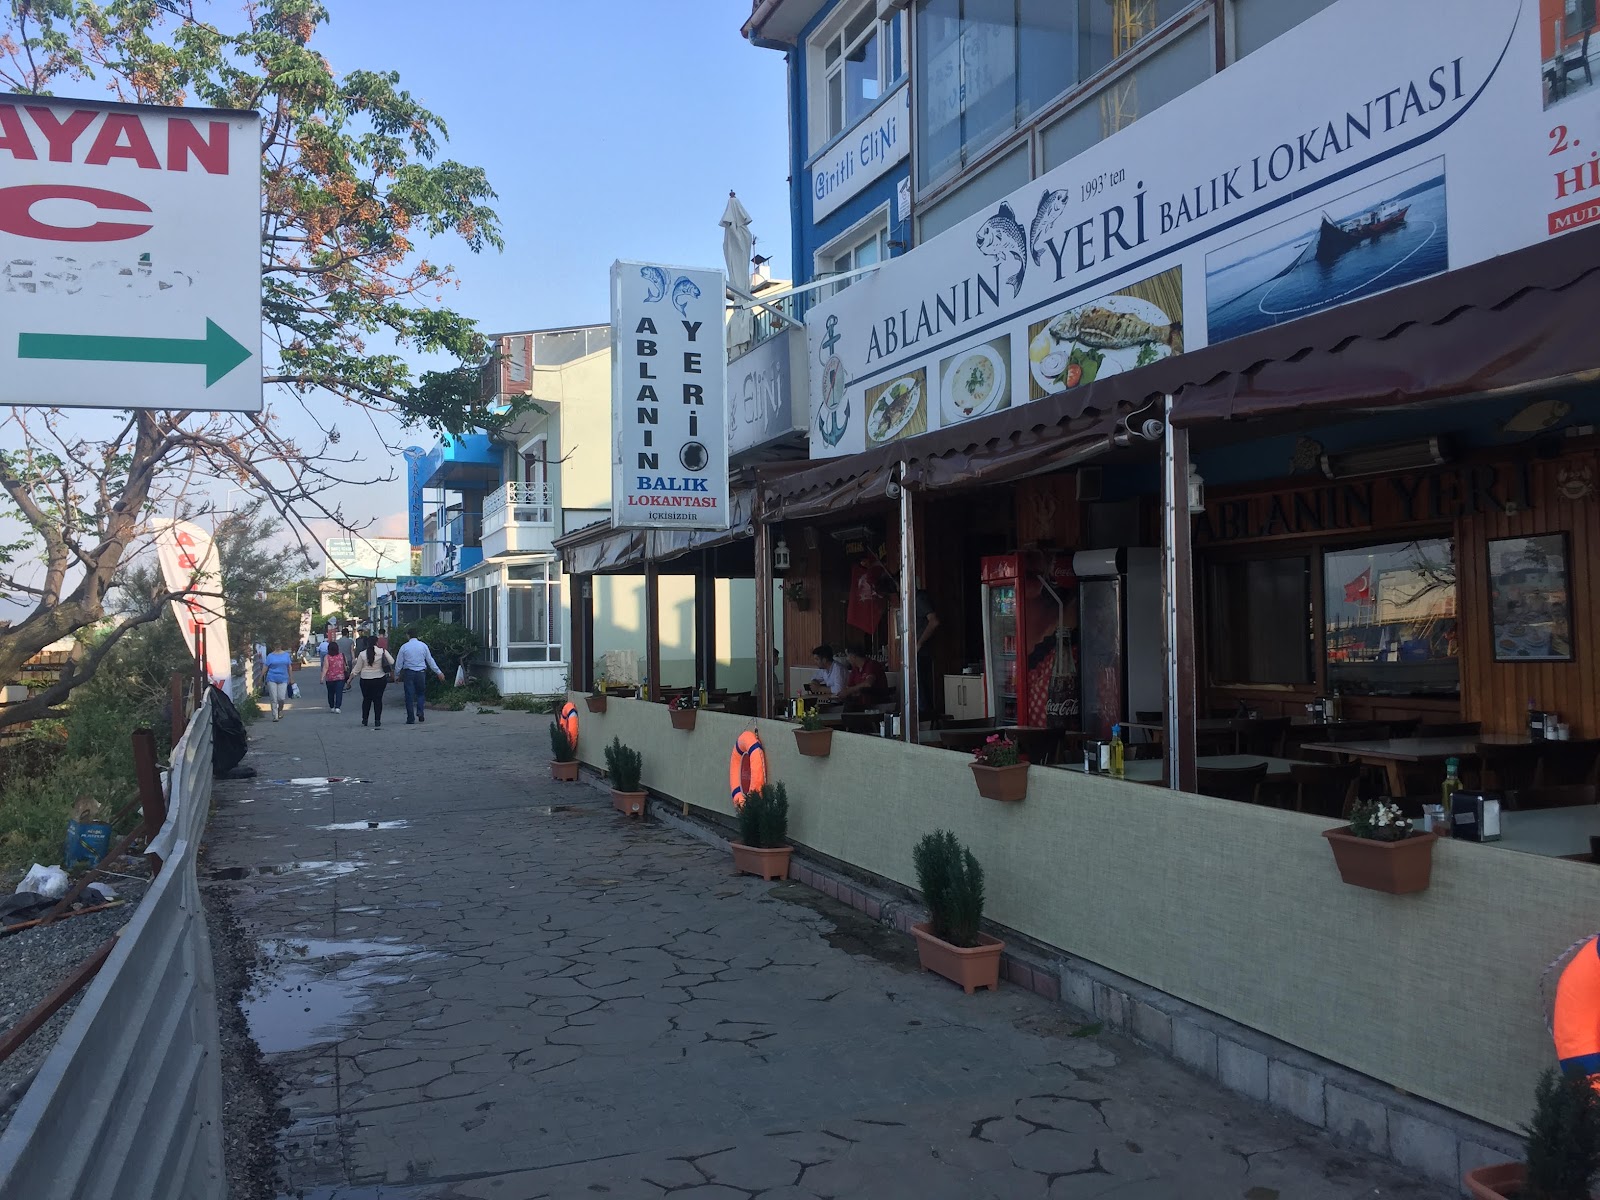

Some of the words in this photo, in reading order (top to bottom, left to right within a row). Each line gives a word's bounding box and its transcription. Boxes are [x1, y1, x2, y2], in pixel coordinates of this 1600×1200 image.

[1548, 125, 1580, 156] 2.
[865, 263, 1002, 364] ABLANIN
[1045, 180, 1150, 283] YERİ
[1159, 166, 1244, 236] BALIK
[1251, 56, 1466, 193] LOKANTASI
[635, 317, 659, 470] ABLANIN
[681, 320, 704, 437] YERİ
[627, 495, 717, 508] LOKANTASI
[636, 476, 708, 492] BALIK
